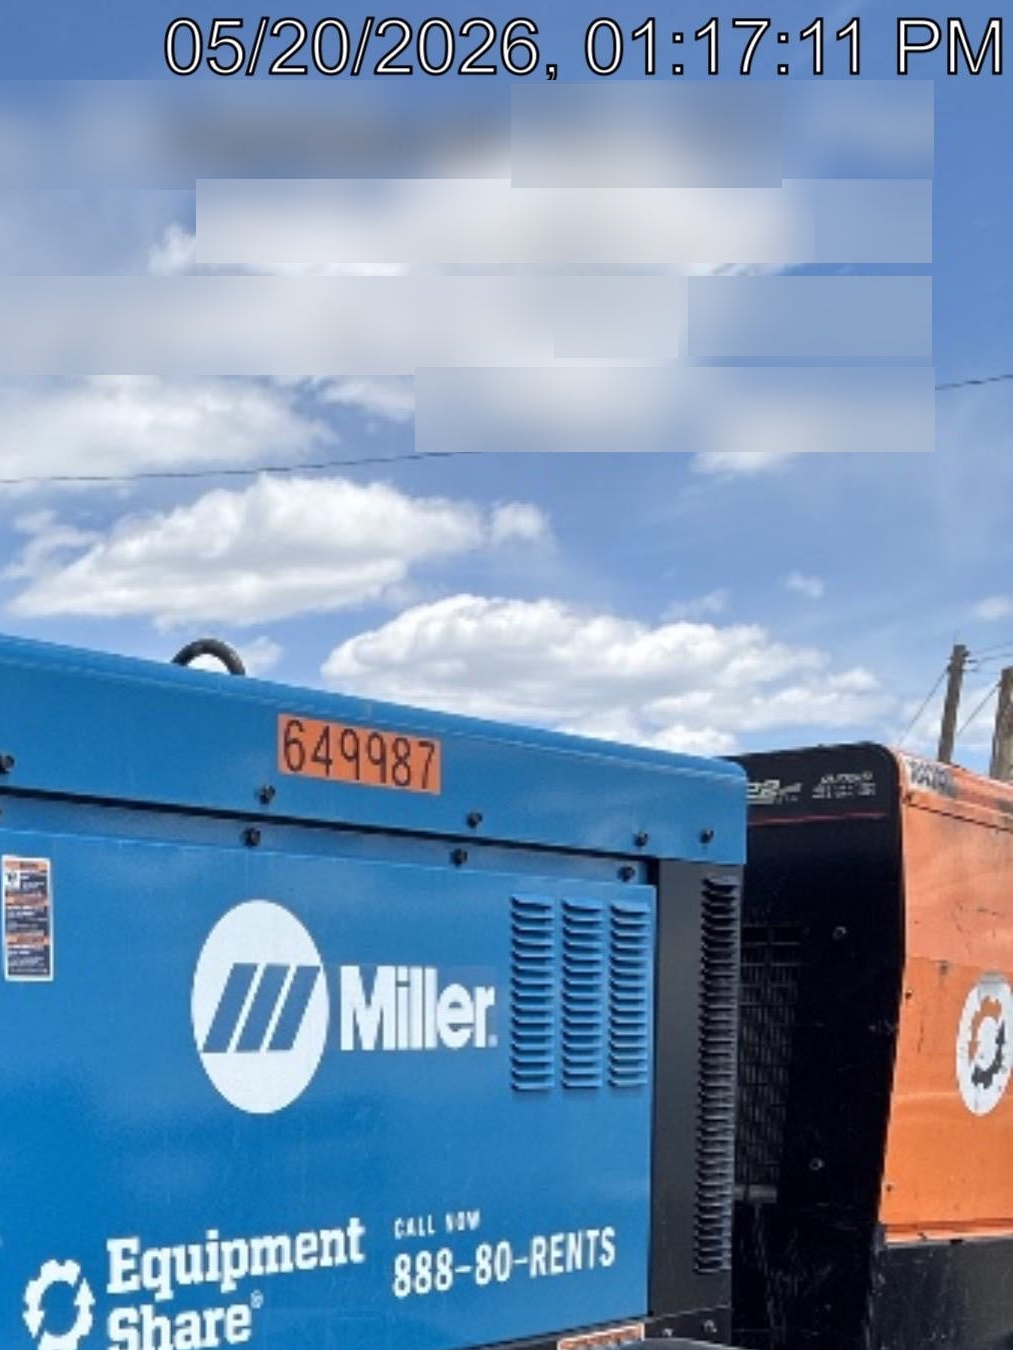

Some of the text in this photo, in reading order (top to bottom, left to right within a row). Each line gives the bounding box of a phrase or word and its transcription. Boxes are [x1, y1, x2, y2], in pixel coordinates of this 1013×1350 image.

[283, 719, 437, 790] 649987
[340, 965, 496, 1051] Miller
[106, 1217, 366, 1302] Equipment
[394, 1208, 481, 1241] CALL NOW
[392, 1226, 617, 1299] 888-80-RENTS
